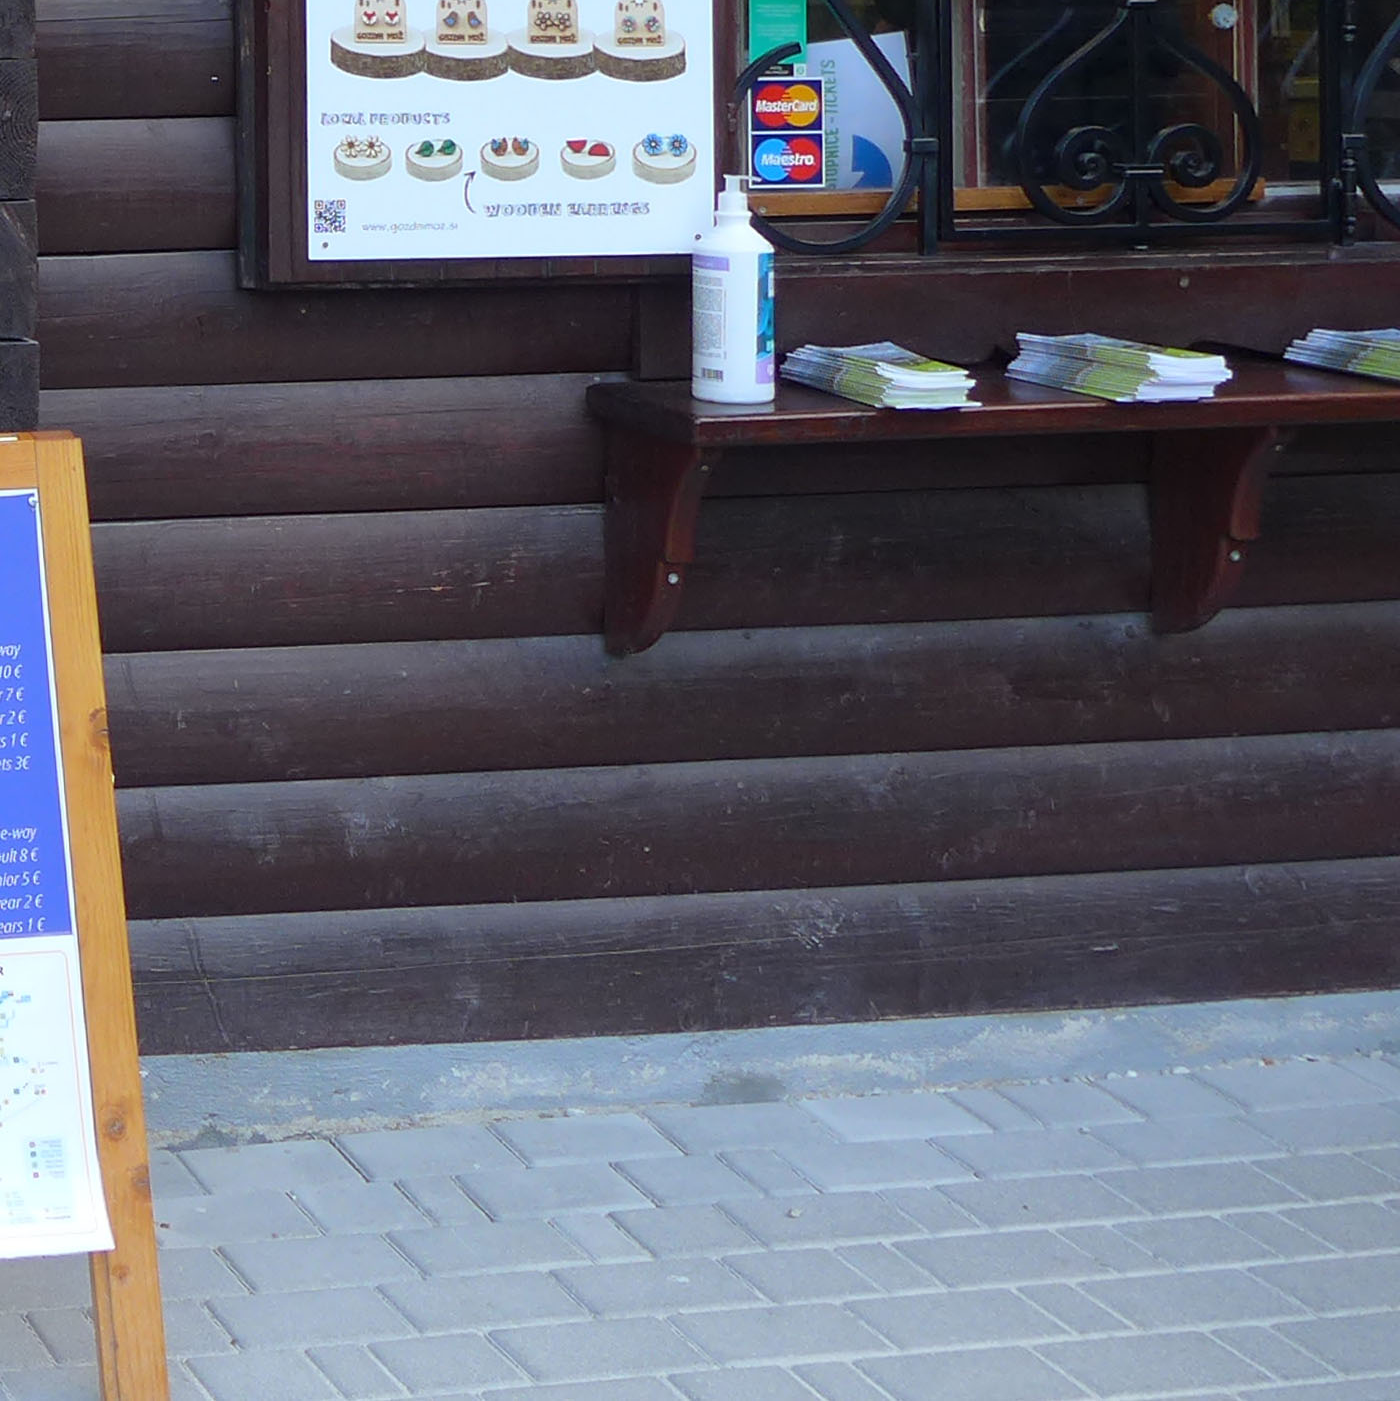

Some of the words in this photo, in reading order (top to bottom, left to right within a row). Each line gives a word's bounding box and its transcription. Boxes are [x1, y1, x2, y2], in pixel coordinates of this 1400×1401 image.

[754, 99, 819, 113] MasterCard
[760, 153, 815, 166] Maestro
[13, 663, 23, 679] €
[5, 687, 14, 702] 7
[15, 686, 25, 702] €
[6, 709, 16, 726] 2
[18, 709, 27, 726] €
[19, 732, 29, 748] €
[14, 755, 31, 771] 3€
[18, 847, 29, 863] 8
[30, 847, 39, 863] €
[21, 870, 30, 886] 5
[32, 870, 41, 886] €
[24, 895, 33, 910] 2
[34, 893, 44, 909] €
[35, 917, 46, 932] €
